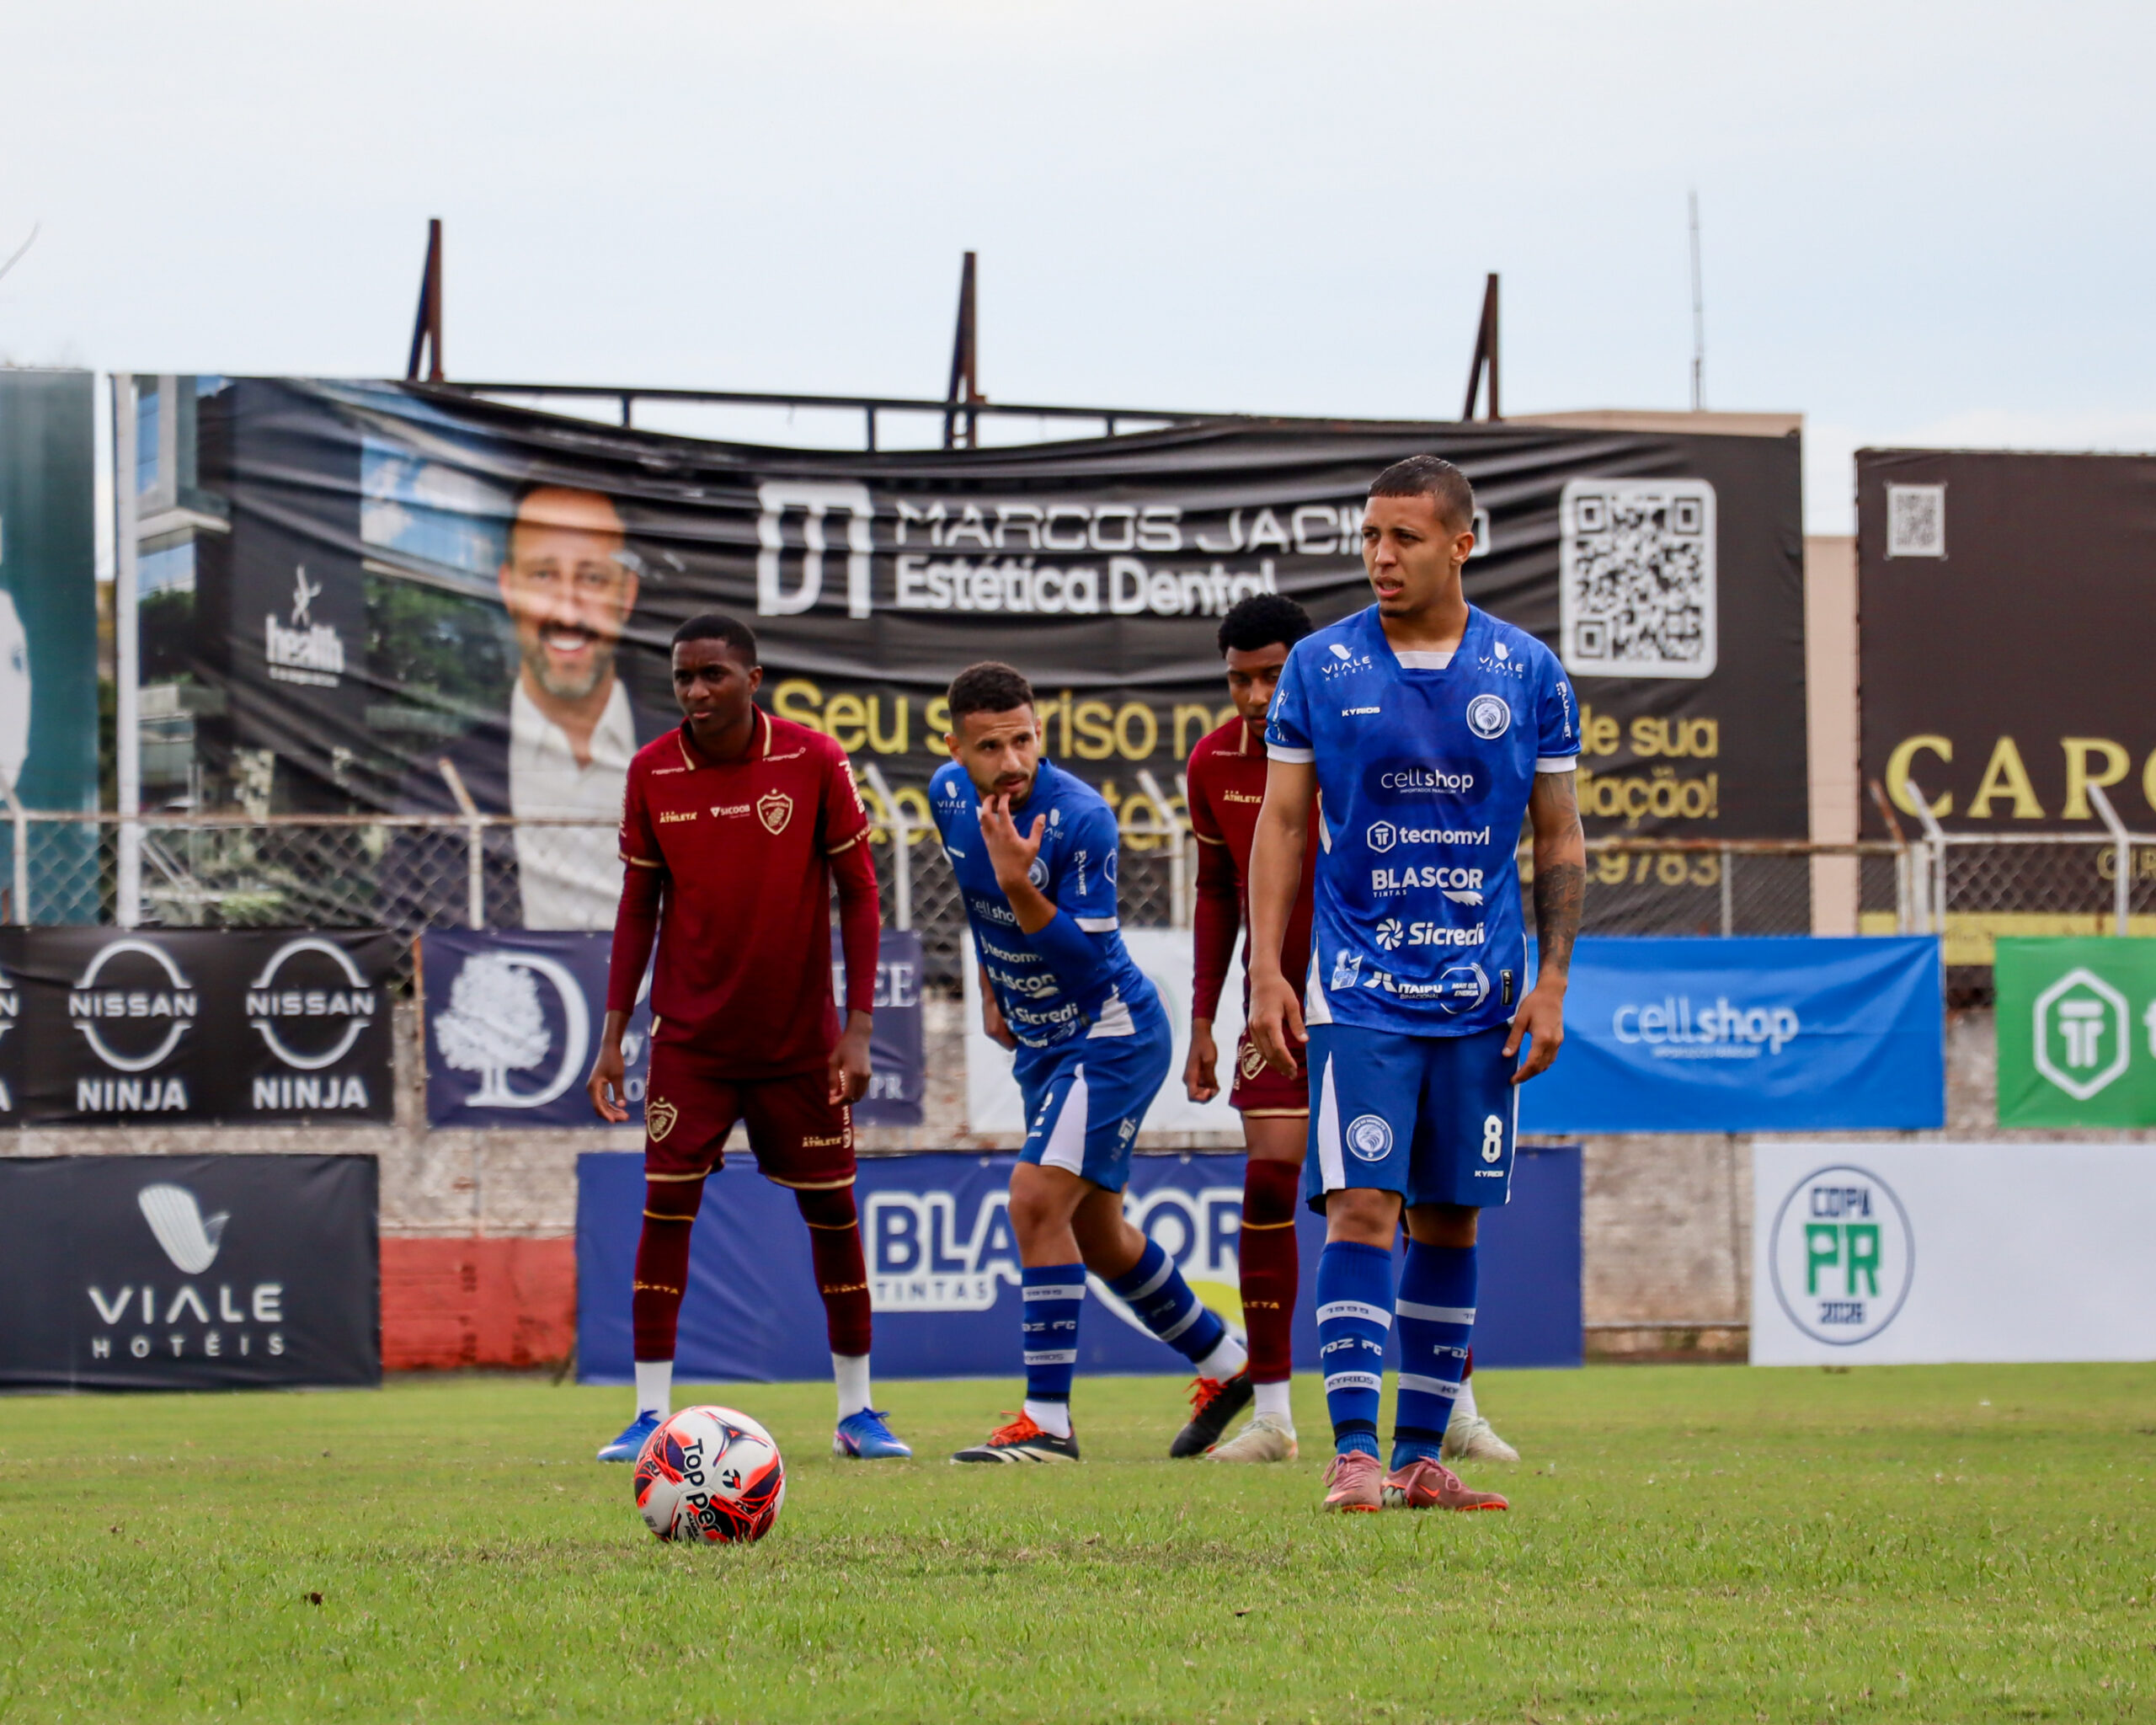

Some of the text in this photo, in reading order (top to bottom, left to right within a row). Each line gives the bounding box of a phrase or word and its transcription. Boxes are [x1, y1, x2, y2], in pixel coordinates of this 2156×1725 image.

[894, 500, 1491, 557] MARCOS JACI
[895, 553, 1098, 614] Estética
[1321, 656, 1371, 674] VIALE
[1479, 657, 1524, 672] VIALE
[773, 679, 908, 754] Seu
[925, 687, 1158, 760] sriso
[1173, 702, 1240, 760] n
[1342, 708, 1380, 717] KYRIOS
[1630, 717, 1718, 757] sua
[1380, 768, 1473, 793] cellshop
[659, 813, 697, 823] ATHLETA
[1399, 825, 1490, 845] tecnomyl
[1372, 867, 1483, 890] BLASCOR
[1374, 889, 1406, 898] TINTAS
[1408, 922, 1485, 945] Sicredi
[1398, 984, 1443, 993] ITAIPU
[69, 992, 196, 1017] NISSAN
[247, 991, 375, 1016] NISSAN
[1016, 1002, 1079, 1025] Sicredi
[1613, 996, 1800, 1055] cellshop
[77, 1078, 188, 1111] NINJA
[254, 1076, 368, 1109] NINJA
[1481, 1114, 1503, 1163] 8
[1813, 1188, 1870, 1216] COPA
[873, 1199, 1245, 1274] BLAOR
[1805, 1224, 1880, 1295] PR
[876, 1279, 990, 1303] TINTAS
[88, 1284, 284, 1324] VIALE
[93, 1331, 285, 1358] HOTÉIS
[1328, 1376, 1374, 1387] KYRIOS
